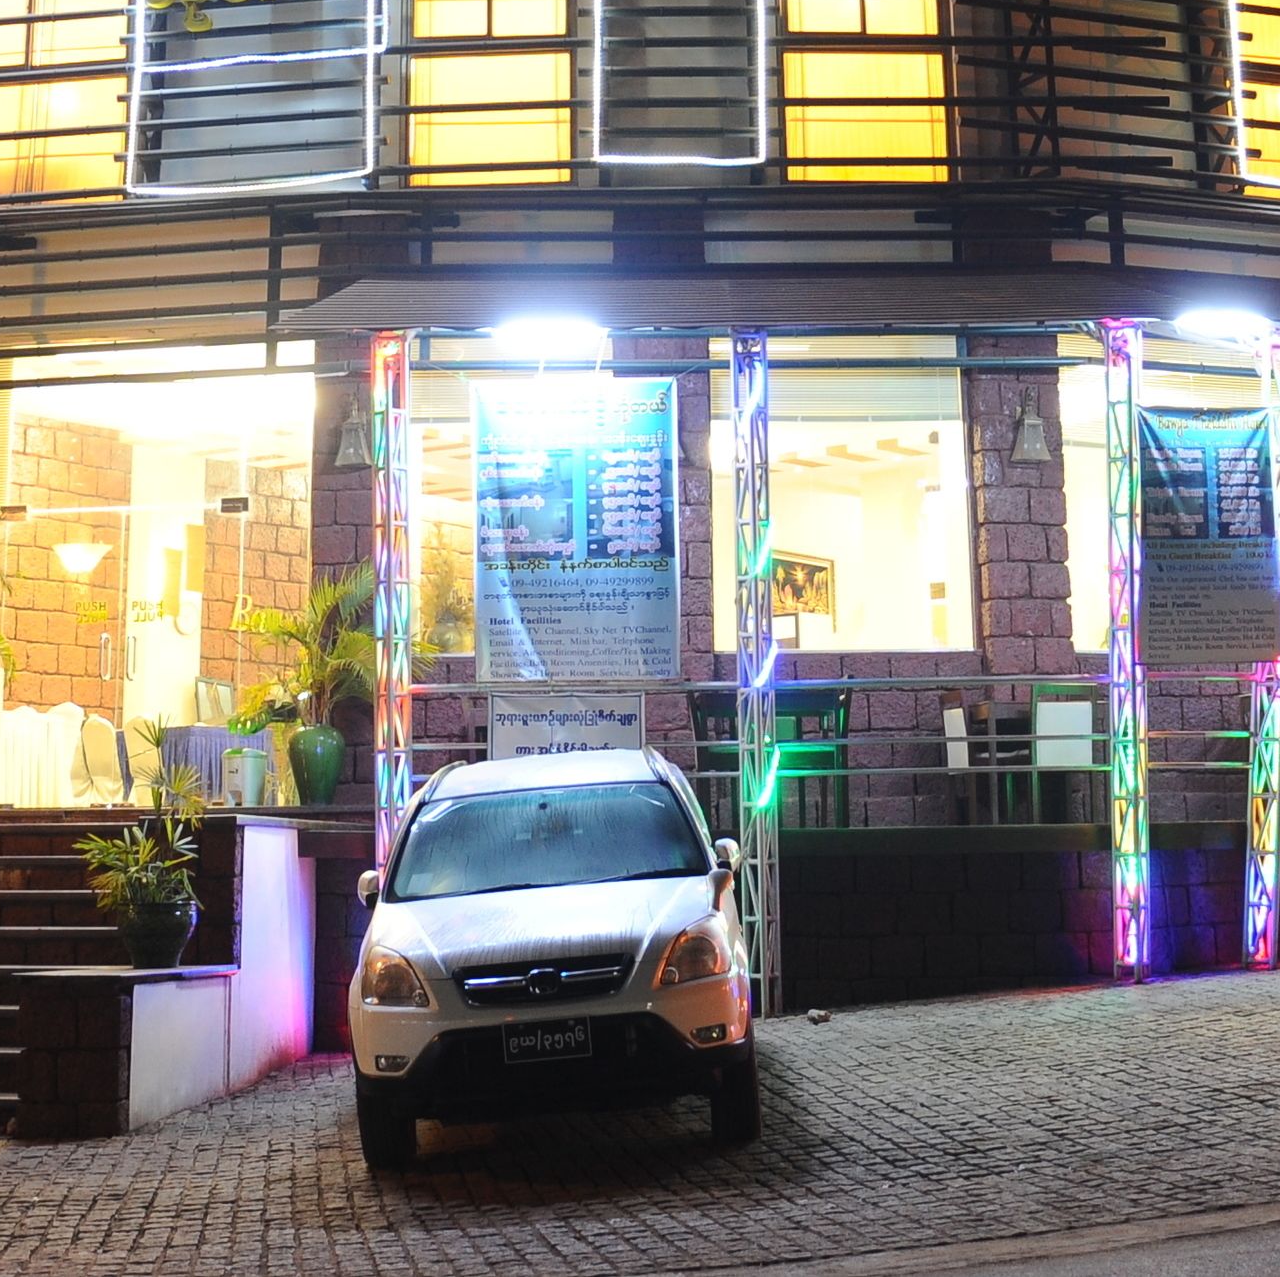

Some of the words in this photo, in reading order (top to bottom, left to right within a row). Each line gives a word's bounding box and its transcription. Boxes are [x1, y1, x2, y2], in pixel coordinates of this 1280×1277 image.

[75, 601, 107, 612] PUSH
[1149, 601, 1168, 609] Hotel
[1172, 601, 1201, 609] Facilities
[489, 618, 514, 626] Hotel
[521, 617, 562, 625] Facilities
[527, 627, 539, 635] TV
[584, 626, 599, 637] Sky
[602, 627, 617, 635] Net
[489, 638, 514, 647] Email
[613, 637, 655, 647] Telephone
[640, 647, 671, 657] Making
[551, 659, 576, 667] Room
[624, 658, 639, 666] Hot
[651, 657, 671, 666] Cold
[570, 669, 595, 678] Room
